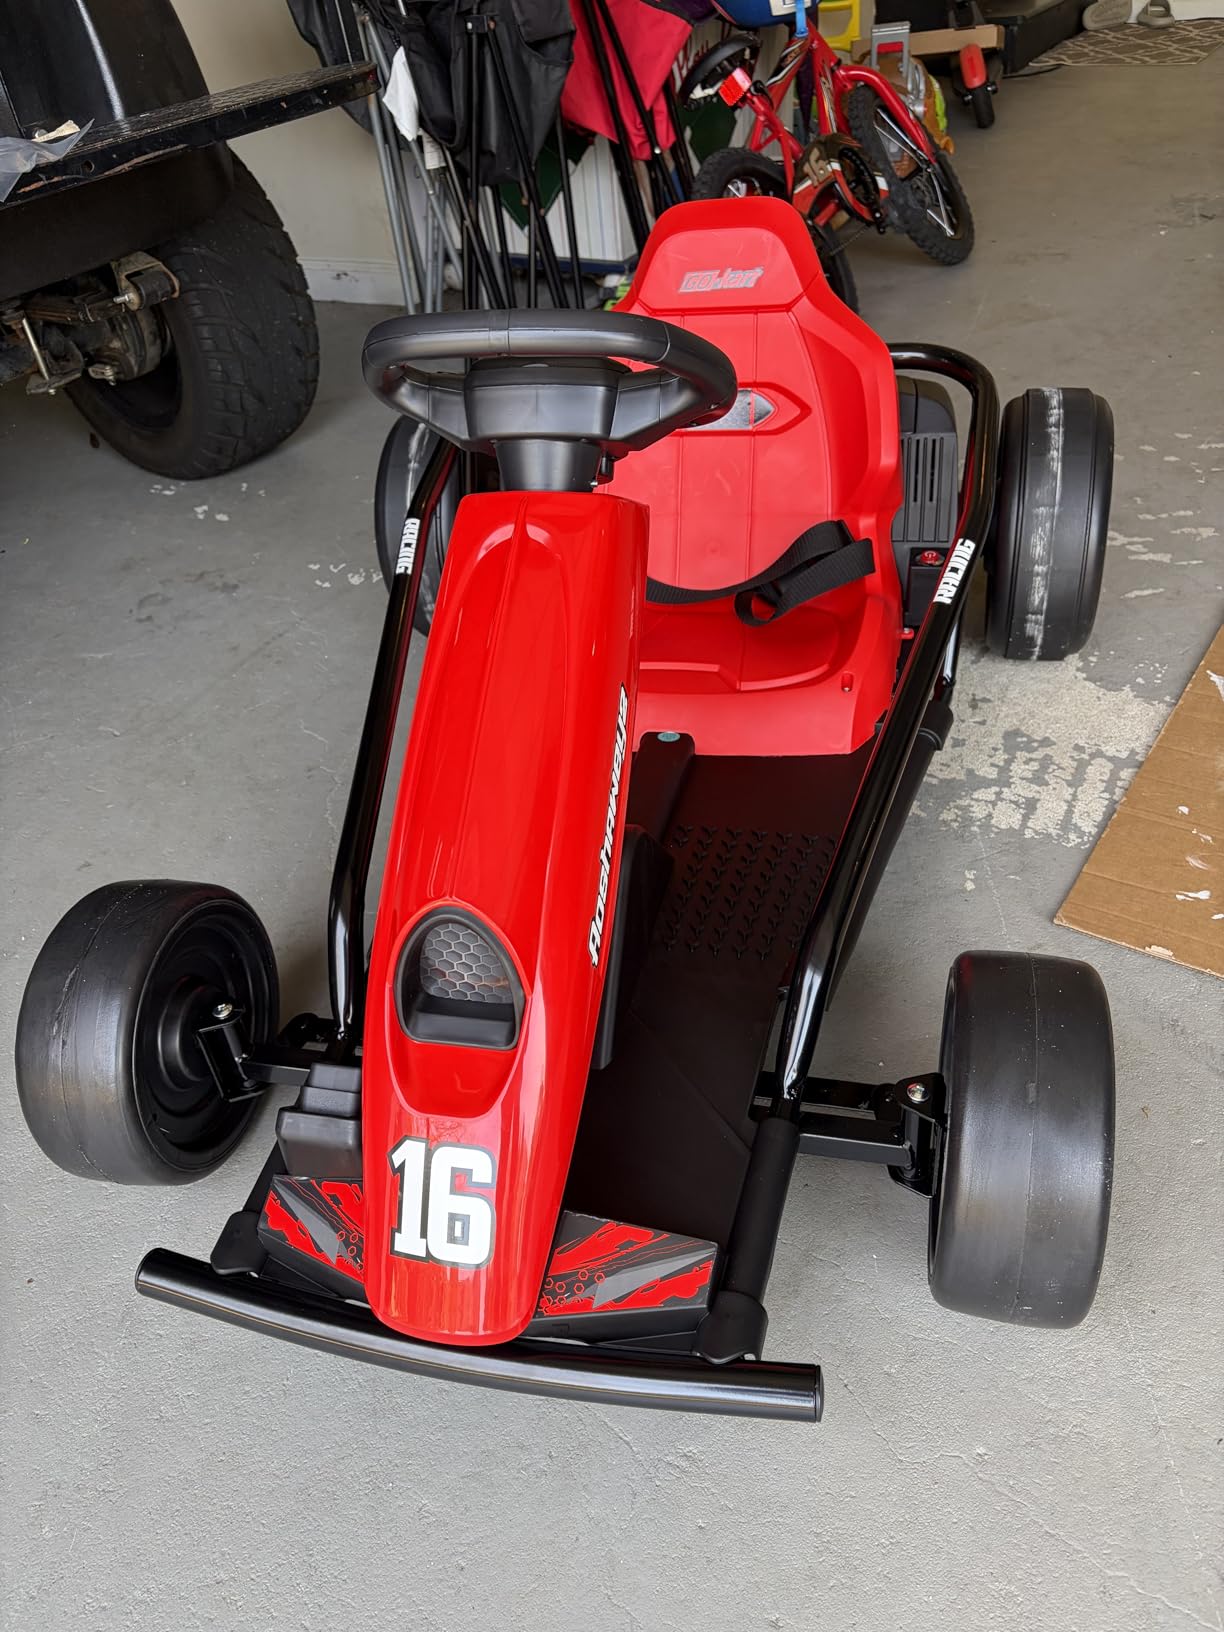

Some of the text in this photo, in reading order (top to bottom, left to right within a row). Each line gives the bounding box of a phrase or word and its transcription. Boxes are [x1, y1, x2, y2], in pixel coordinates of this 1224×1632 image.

[396, 518, 421, 575] RACING
[933, 538, 976, 604] RACING
[387, 1135, 496, 1268] 16
